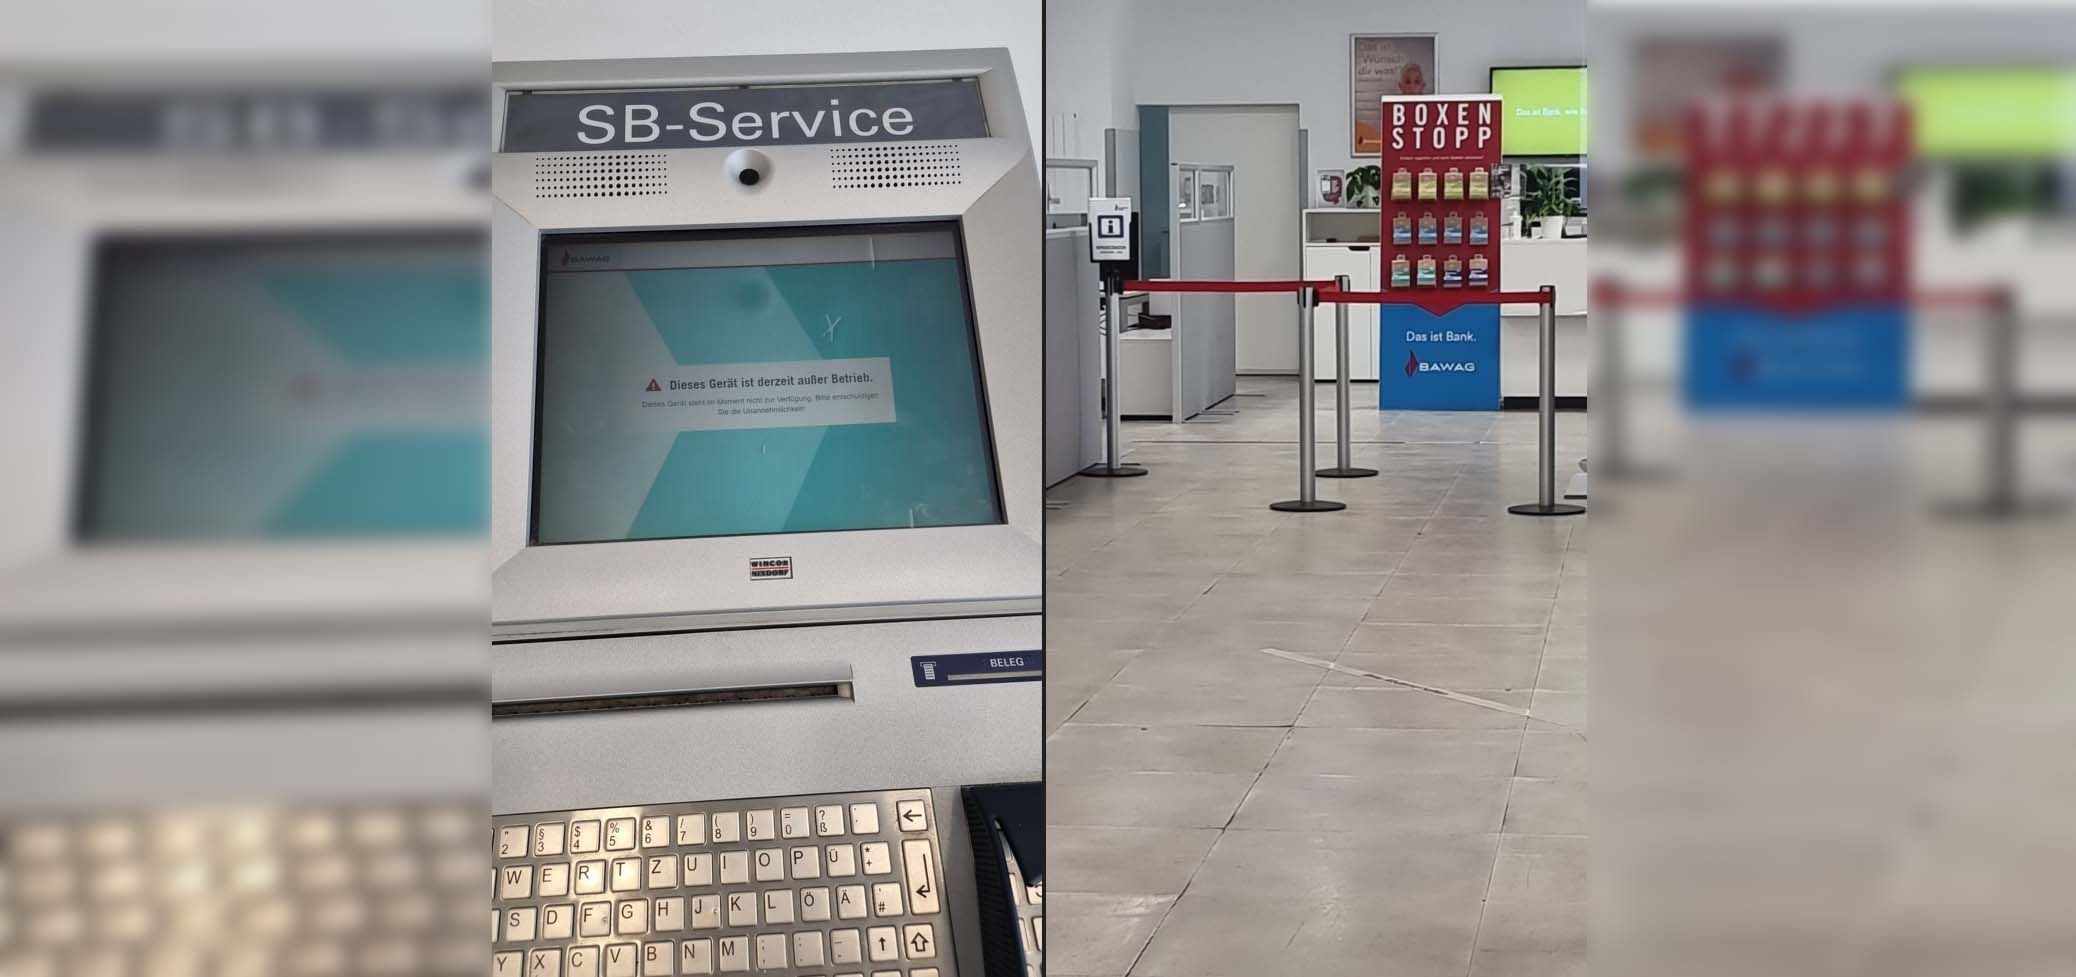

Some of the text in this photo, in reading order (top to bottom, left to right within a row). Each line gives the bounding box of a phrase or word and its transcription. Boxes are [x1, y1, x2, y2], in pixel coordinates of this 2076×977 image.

[577, 98, 915, 144] SB-Service
[1392, 102, 1491, 126] BOXEN
[1392, 126, 1491, 149] STOPP
[1406, 330, 1477, 342] Das ist Bank.
[1419, 362, 1475, 372] BAWAG
[670, 372, 873, 391] Dieses Gerät ist derzeit außer Betrieb.
[990, 657, 1024, 668] BELEG
[574, 826, 581, 837] $
[610, 823, 619, 833] %
[645, 821, 652, 830] &
[819, 810, 825, 820] ?
[502, 844, 508, 854] 2
[538, 842, 544, 852] 3
[574, 839, 580, 850] 4
[610, 836, 616, 846] 5
[645, 834, 651, 843] 6
[680, 831, 686, 841] 7
[715, 829, 721, 839] 8
[750, 827, 756, 836] 9
[507, 871, 522, 884] W
[542, 868, 553, 882] E
[579, 866, 589, 879] R
[616, 863, 626, 876] T
[652, 860, 662, 874] Z
[688, 858, 697, 871] U
[759, 853, 770, 866] O
[793, 851, 804, 864] P
[829, 848, 839, 862] Ü
[510, 890, 851, 927] S D F G H J K L Ö Ä
[497, 942, 735, 971] Y X C V B N M
